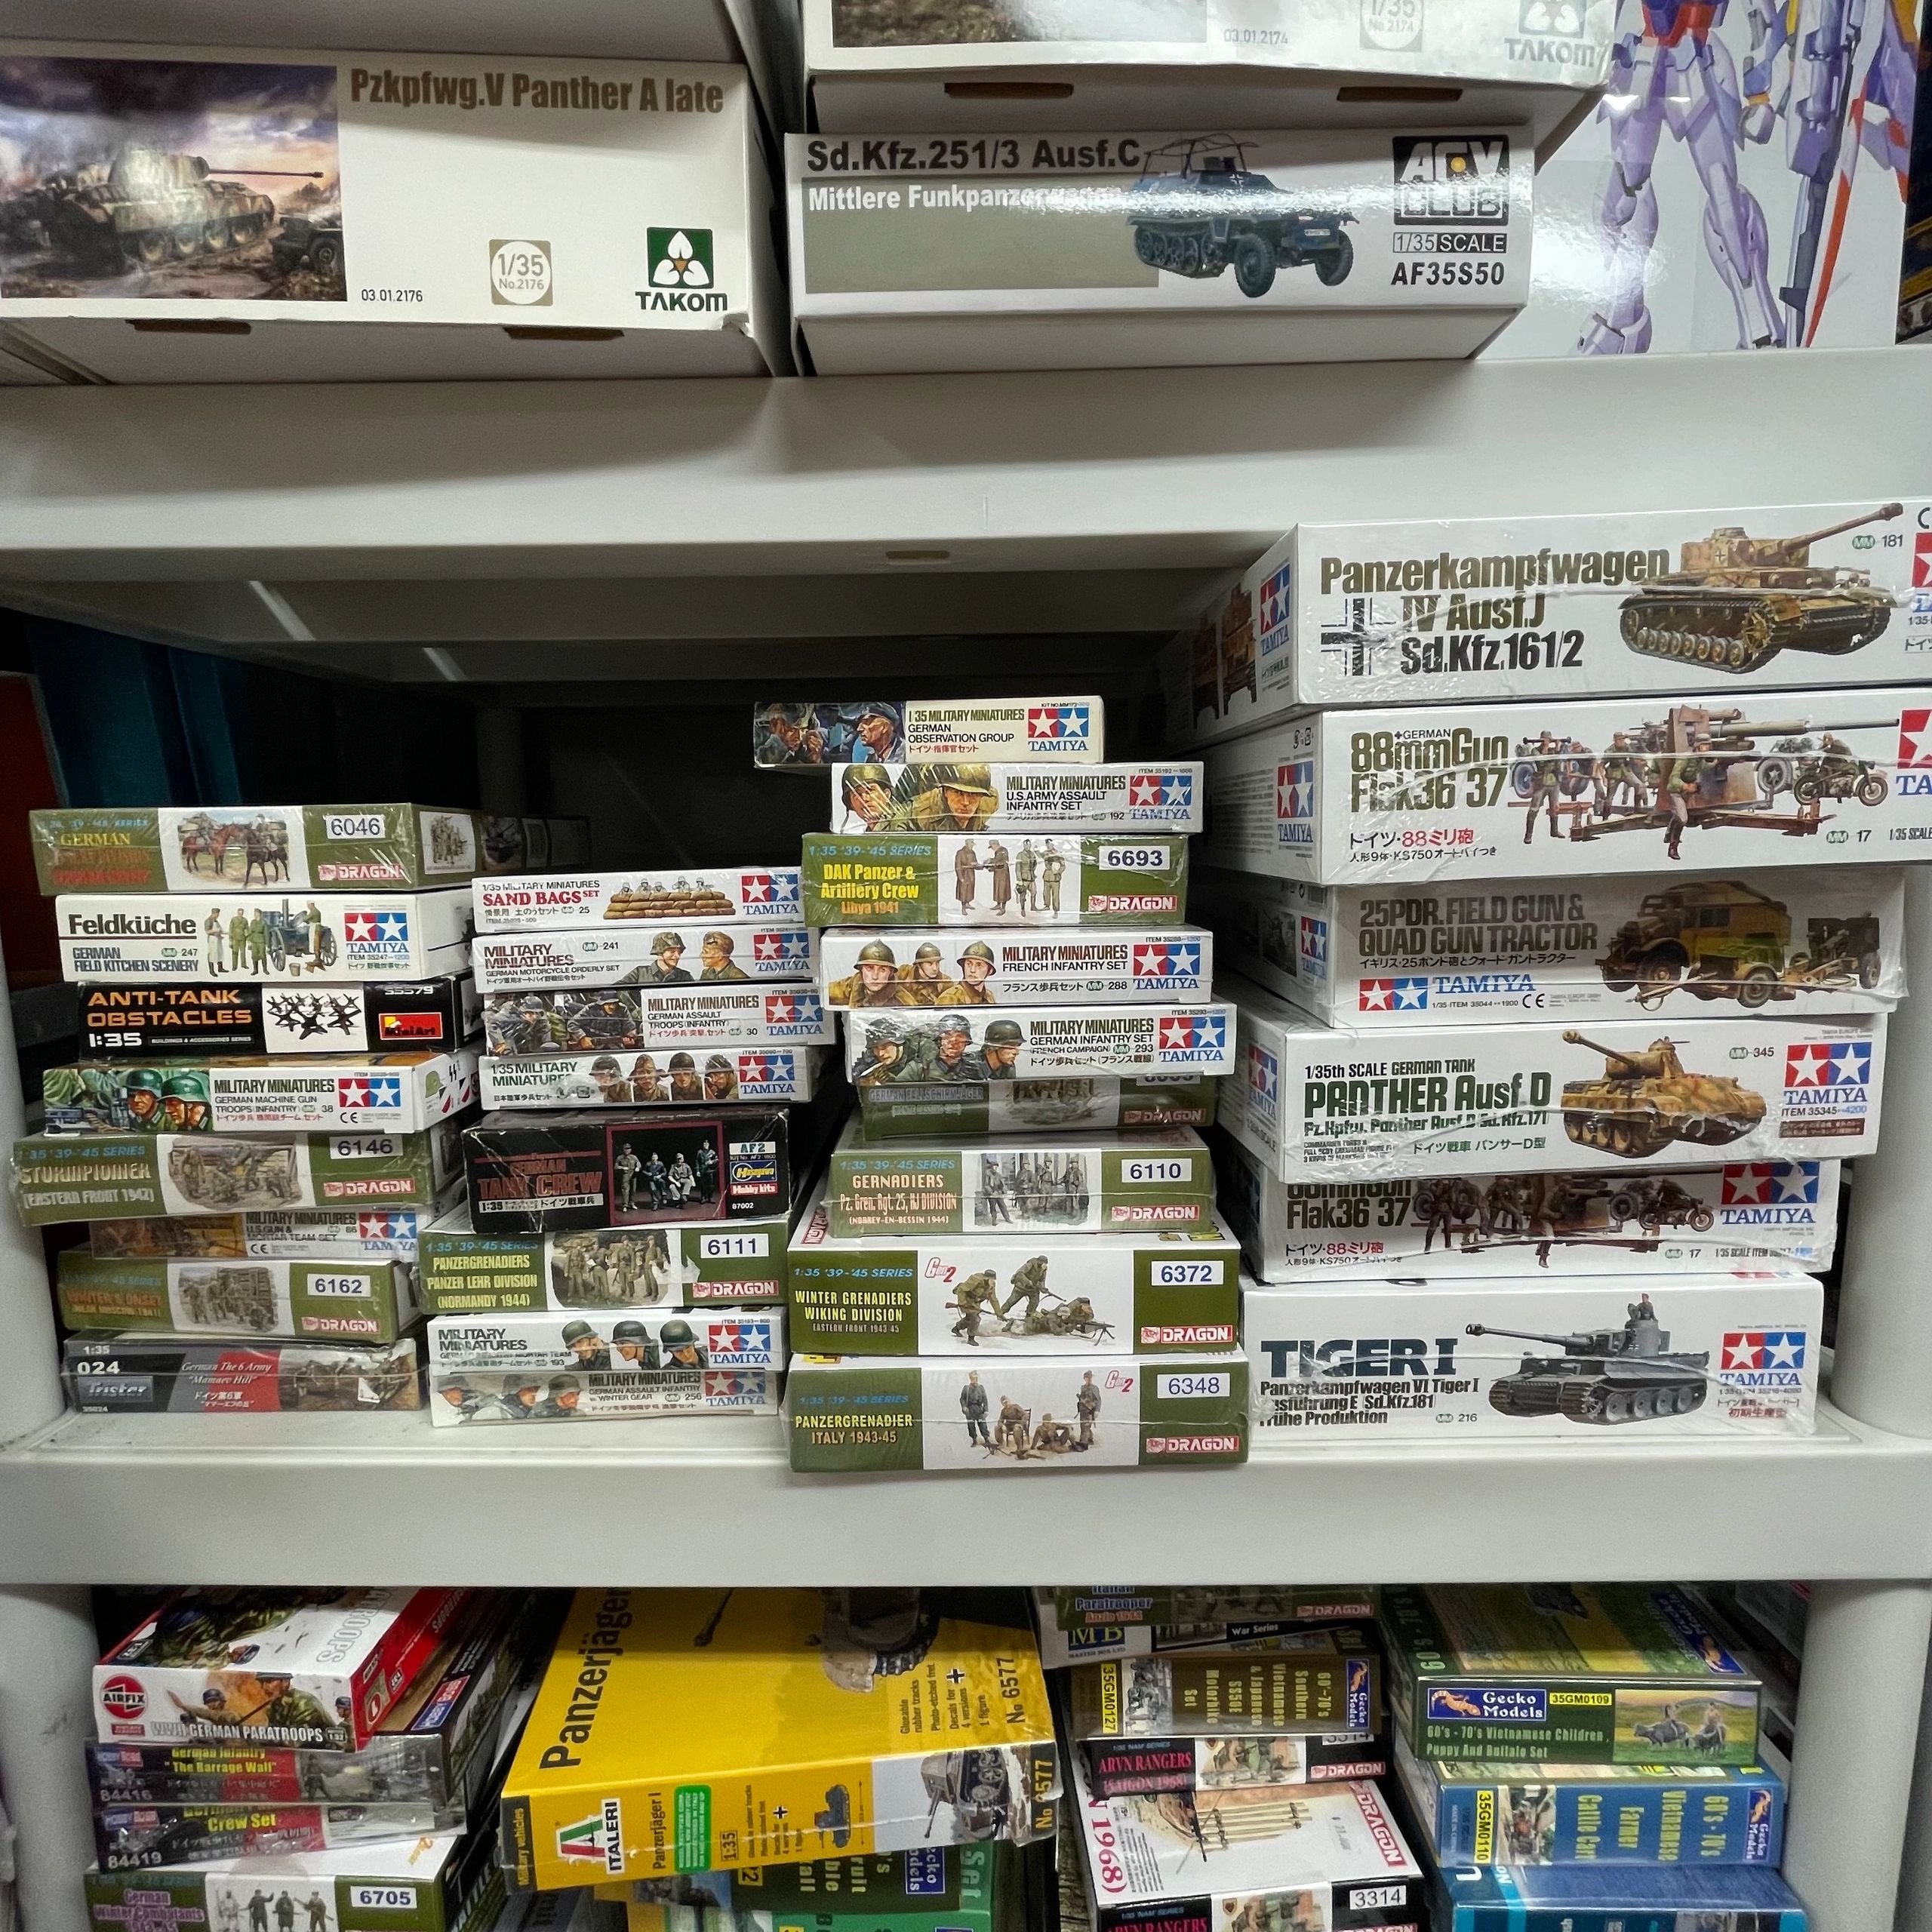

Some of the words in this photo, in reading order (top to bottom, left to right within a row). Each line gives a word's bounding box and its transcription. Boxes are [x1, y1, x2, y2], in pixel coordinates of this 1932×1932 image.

[1223, 29, 1288, 45] 03.01.2174
[1504, 38, 1596, 68] TAKOM
[351, 69, 505, 109] Pzkpfwg.V
[513, 73, 632, 111] Panther
[640, 78, 659, 112] A
[666, 78, 723, 113] late
[807, 139, 1021, 171] Sd.Kfz.251/3
[1032, 138, 1141, 169] Ausf.C
[808, 186, 901, 211] Mittlere
[498, 254, 544, 278] 1/35
[1390, 261, 1506, 286] AF35S50
[499, 278, 544, 291] No.2176
[361, 288, 423, 302] 03.01.2176
[635, 291, 728, 312] TAKOM
[1881, 534, 1904, 548] 181
[1320, 547, 1670, 595] Panzerkampfwagen
[1401, 628, 1585, 675] Sd.Kfz.161/2
[908, 724, 952, 733] GERMAN
[1402, 728, 1451, 740] GERMAN
[908, 734, 976, 743] OBSERVATION
[979, 733, 1015, 743] GROUP
[1027, 740, 1089, 752] TAMIYA
[1006, 776, 1057, 791] MILITARY
[1059, 775, 1126, 791] MINIATURES
[1350, 770, 1457, 813] Flak36
[1466, 768, 1508, 808] 37
[1006, 801, 1058, 811] INFANTRY
[1060, 800, 1083, 811] SET
[331, 819, 380, 836] 6046
[1857, 829, 1872, 842] 17
[1107, 850, 1164, 867] 6693
[483, 892, 531, 906] SAND
[536, 891, 583, 905] BAGS
[583, 890, 600, 898] SET
[743, 903, 799, 915] TAMIYA
[69, 913, 196, 935] Feldküche
[1359, 927, 1426, 957] QUAD
[1430, 925, 1484, 955] GUN
[1486, 922, 1598, 952] TRACTOR
[72, 947, 121, 959] GERMAN
[346, 943, 409, 954] TAMIYA
[484, 944, 552, 957] MILITARY
[1003, 946, 1057, 962] MILITARY
[1057, 944, 1128, 961] MINIATURES
[1002, 962, 1049, 973] FRENCH
[1051, 961, 1106, 971] INFANTRY
[1106, 961, 1128, 971] SET
[1432, 974, 1537, 995] TAMIYA
[88, 989, 241, 1006] ANTI-TANK
[648, 997, 697, 1011] MILITARY
[697, 995, 759, 1009] MINIATURES
[88, 1009, 252, 1027] OBSTACLES
[766, 1025, 824, 1036] TAMIYA
[1030, 1020, 1083, 1036] MILITARY
[1084, 1018, 1154, 1034] MINIATURES
[1030, 1035, 1078, 1046] GERMAN
[1080, 1035, 1131, 1044] INFANTRY
[1133, 1034, 1154, 1043] SET
[1159, 1050, 1225, 1063] TAMIYA
[1753, 1047, 1774, 1057] 345
[515, 1061, 579, 1074] MILITARY
[1305, 1063, 1345, 1079] 1/35th
[1348, 1063, 1388, 1078] SCALE
[1391, 1060, 1442, 1076] GERMAN
[1444, 1058, 1475, 1073] TANK
[214, 1079, 266, 1094] MILITARY
[266, 1078, 335, 1093] MINIATURES
[740, 1083, 796, 1094] TAMIYA
[1783, 1088, 1868, 1106] TAMIYA
[337, 1139, 393, 1156] 6146
[1130, 1163, 1181, 1180] 6110
[345, 1180, 412, 1195] DRAGON
[852, 1174, 944, 1189] GERNADIERS
[246, 1212, 294, 1225] MILITARY
[295, 1211, 357, 1225] MINIATURES
[1131, 1206, 1198, 1221] DRAGON
[1287, 1198, 1369, 1229] Flak36
[1377, 1197, 1411, 1226] 37
[1721, 1208, 1816, 1225] TAMIYA
[707, 1238, 757, 1256] 6111
[1689, 1249, 1701, 1258] 17
[1730, 1247, 1751, 1257] SCALE
[432, 1254, 531, 1270] PANZERGRENADIERS
[427, 1275, 464, 1290] PANZER
[466, 1275, 491, 1289] LEHR
[494, 1274, 538, 1288] DIVISION
[1161, 1265, 1213, 1283] 6372
[315, 1278, 362, 1294] 6162
[795, 1291, 838, 1305] WINTER
[841, 1291, 912, 1306] GRENADIERS
[804, 1306, 847, 1321] WIKING
[851, 1307, 903, 1322] DIVISION
[320, 1318, 377, 1332] DRAGON
[438, 1328, 506, 1340] MILITARY
[83, 1346, 110, 1355] 1:35
[710, 1353, 771, 1364] TAMIYA
[1260, 1339, 1429, 1378] TIGER
[1433, 1337, 1458, 1376] I
[77, 1361, 121, 1375] 024
[181, 1361, 218, 1372] German
[220, 1361, 237, 1371] The
[238, 1362, 244, 1371] 6
[245, 1362, 272, 1374] Army
[589, 1373, 641, 1387] MILITARY
[641, 1371, 701, 1385] MINIATURES
[1168, 1377, 1220, 1395] 6348
[1720, 1372, 1802, 1386] TAMIYA
[589, 1387, 624, 1395] GERMAN
[625, 1386, 660, 1395] ASSAULT
[661, 1385, 701, 1393] INFANTRY
[706, 1395, 767, 1407] TAMIYA
[795, 1414, 914, 1429] PANZERGRENADIER
[1306, 1411, 1389, 1426] Produktion
[811, 1431, 845, 1444] ITALY
[1315, 1604, 1372, 1617] DRAGON
[1232, 1626, 1250, 1635] War
[1253, 1623, 1279, 1634] Series
[996, 1657, 1020, 1700] 6577
[103, 1691, 145, 1704] AIRFIX
[1102, 1664, 1116, 1734] 35GM0127
[1482, 1691, 1537, 1705] Gecko
[1551, 1693, 1610, 1706] 35GM0109
[900, 1699, 910, 1734] Glueable
[1482, 1704, 1543, 1718] Models
[188, 1723, 240, 1739] GERMAN
[242, 1725, 323, 1743] PARATROOPS
[1099, 1754, 1134, 1774] ARVN
[1134, 1750, 1192, 1771] RANGERS
[1327, 1762, 1385, 1777] DRAGON
[207, 1816, 248, 1832] Crew
[251, 1813, 276, 1828] Set
[1357, 1792, 1403, 1866] DRAGON
[1475, 1792, 1493, 1862] 35GM0110
[604, 1801, 623, 1872] ITALERI
[1746, 1823, 1759, 1860] Models
[1758, 1823, 1769, 1857] Gecko
[721, 1832, 737, 1860] 1:35
[108, 1850, 162, 1869] 84419
[1091, 1815, 1128, 1894] 1968)
[359, 1890, 411, 1906] 6705
[1355, 1890, 1402, 1909] 3314
